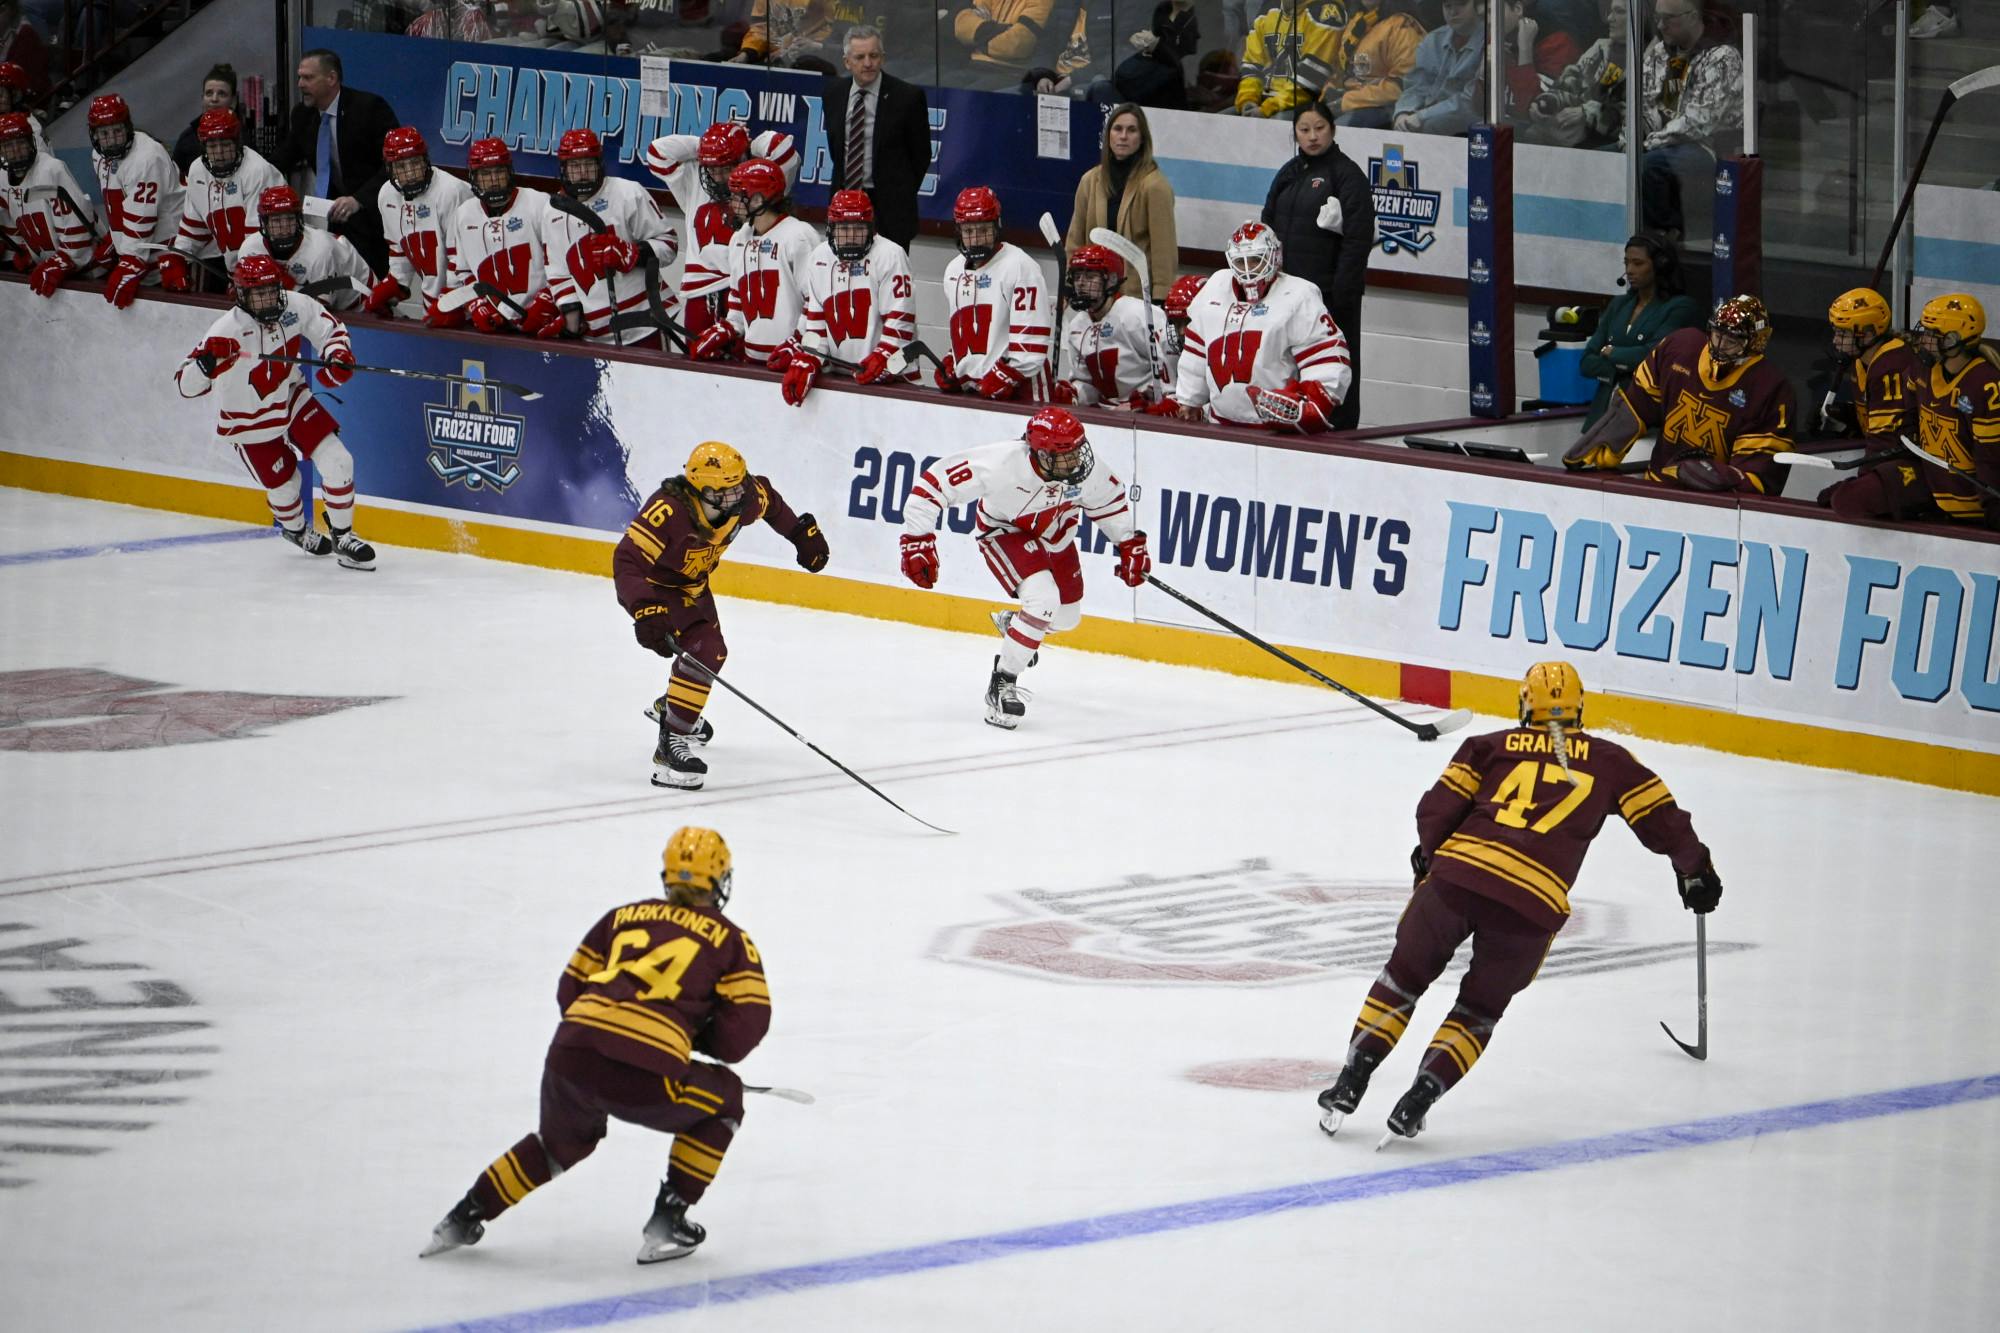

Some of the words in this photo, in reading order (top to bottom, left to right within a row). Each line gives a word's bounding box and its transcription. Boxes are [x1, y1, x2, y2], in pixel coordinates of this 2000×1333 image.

[759, 91, 796, 124] WIN
[52, 197, 73, 217] 20
[134, 182, 158, 204] 22
[1372, 194, 1400, 214] OZEN
[1402, 198, 1433, 219] FOUR
[15, 212, 57, 258] W
[206, 206, 246, 254] W
[400, 230, 438, 279] W
[770, 242, 779, 260] A
[477, 243, 532, 296] W
[863, 259, 871, 276] C
[738, 269, 780, 327] W
[892, 275, 912, 299] 26
[1013, 287, 1038, 311] 27
[823, 288, 871, 348] W
[950, 303, 992, 365] W
[1208, 330, 1263, 392] W
[1882, 373, 1903, 400] 11
[1983, 382, 2000, 411] 2
[1664, 389, 1732, 464] M
[1777, 404, 1787, 429] 1
[435, 417, 481, 442] FROZEN
[484, 423, 516, 447] FOUR
[1920, 404, 1976, 474] M
[945, 460, 974, 487] 18
[641, 499, 674, 528] 16
[901, 542, 934, 552] CCM
[848, 446, 978, 534] 20
[1159, 488, 1411, 597] WOMEN'S
[1437, 500, 1809, 680] FROZEN
[1834, 554, 2000, 714] FOU
[634, 604, 669, 620] CCM
[1550, 688, 1562, 699] 47
[1490, 760, 1594, 834] 47
[612, 904, 729, 948] PARKKONEN
[588, 929, 701, 1001] 64
